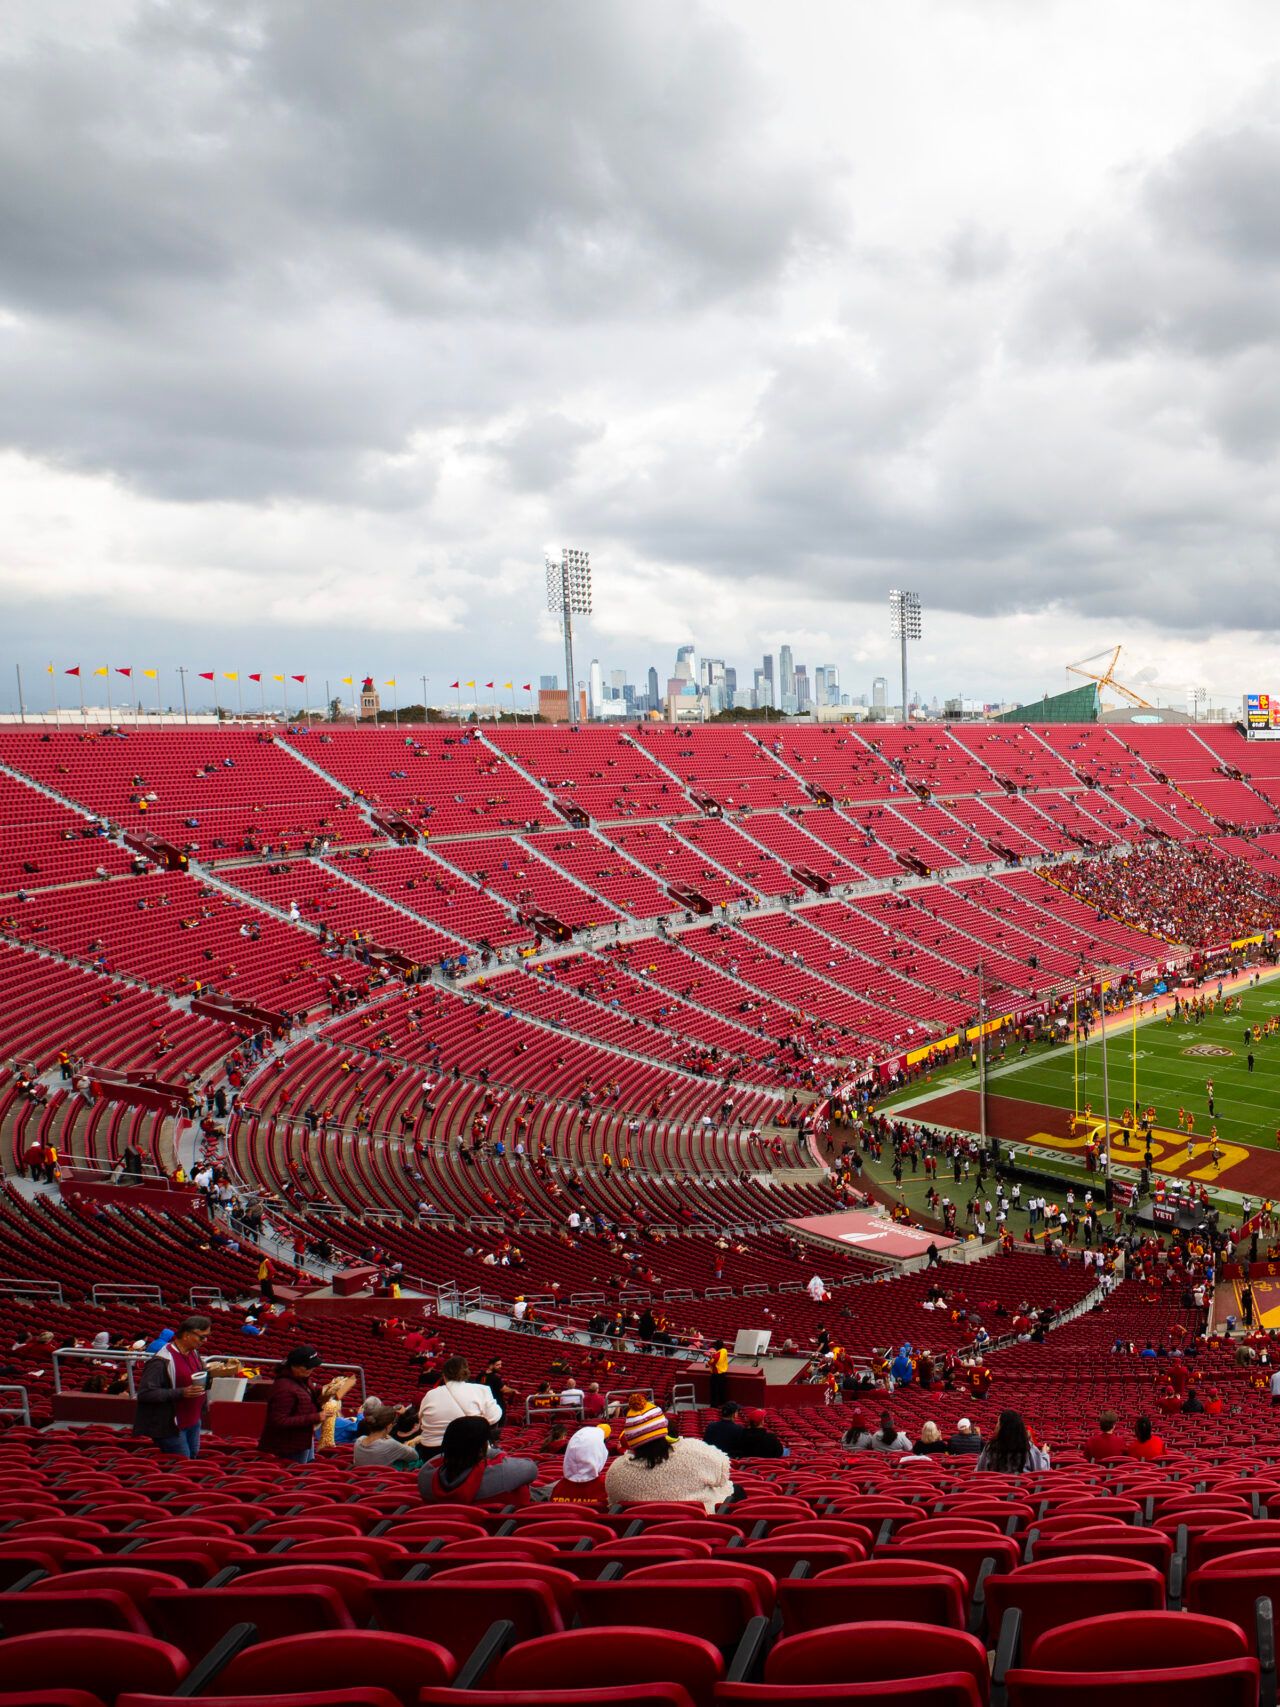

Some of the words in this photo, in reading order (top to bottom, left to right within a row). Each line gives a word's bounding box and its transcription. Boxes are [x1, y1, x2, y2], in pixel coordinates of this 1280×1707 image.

[1141, 966, 1158, 982] Coca-Cola
[1025, 1115, 1250, 1181] USC
[1155, 1210, 1172, 1221] YETI
[973, 1373, 980, 1385] 5
